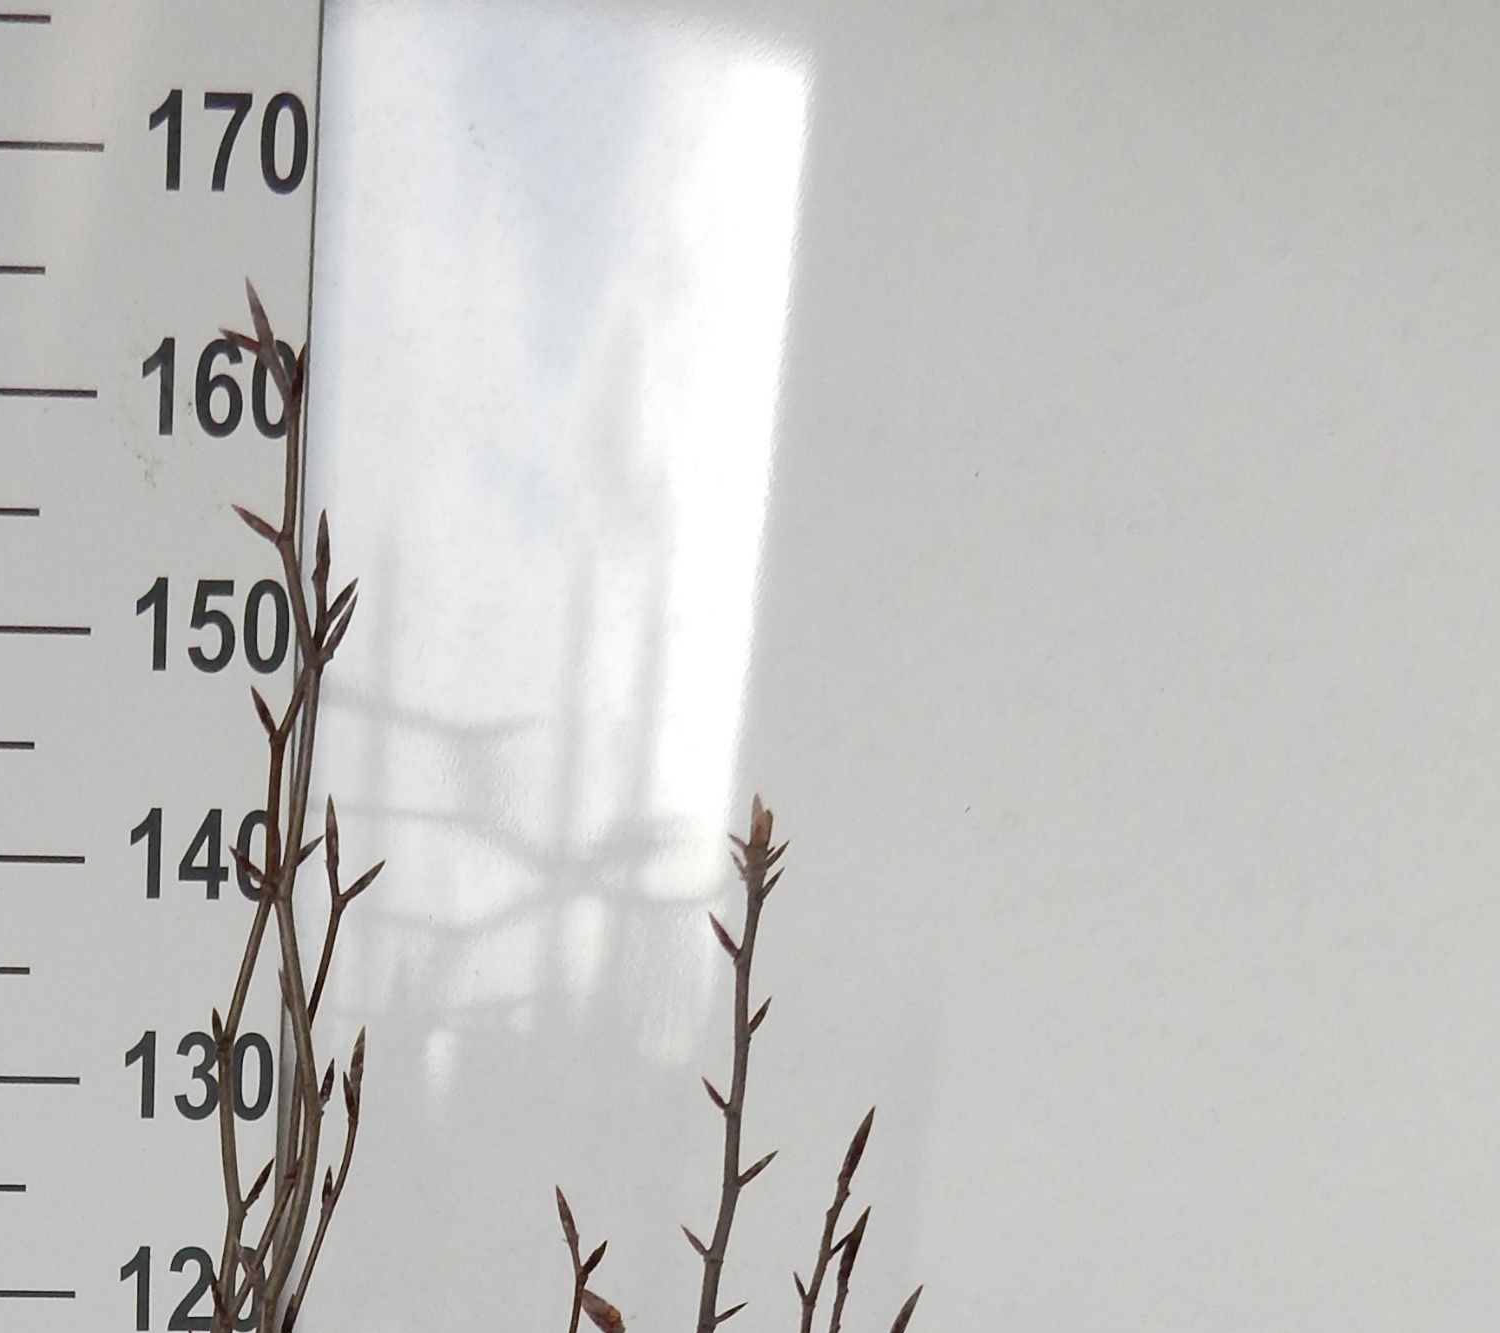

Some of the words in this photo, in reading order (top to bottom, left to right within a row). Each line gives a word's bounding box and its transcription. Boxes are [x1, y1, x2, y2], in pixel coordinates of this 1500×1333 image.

[148, 88, 309, 194] 170
[142, 337, 298, 438] 160
[136, 576, 290, 673] 150
[130, 807, 278, 901] 140
[125, 1030, 274, 1121] 130
[120, 1246, 264, 1333] 120
